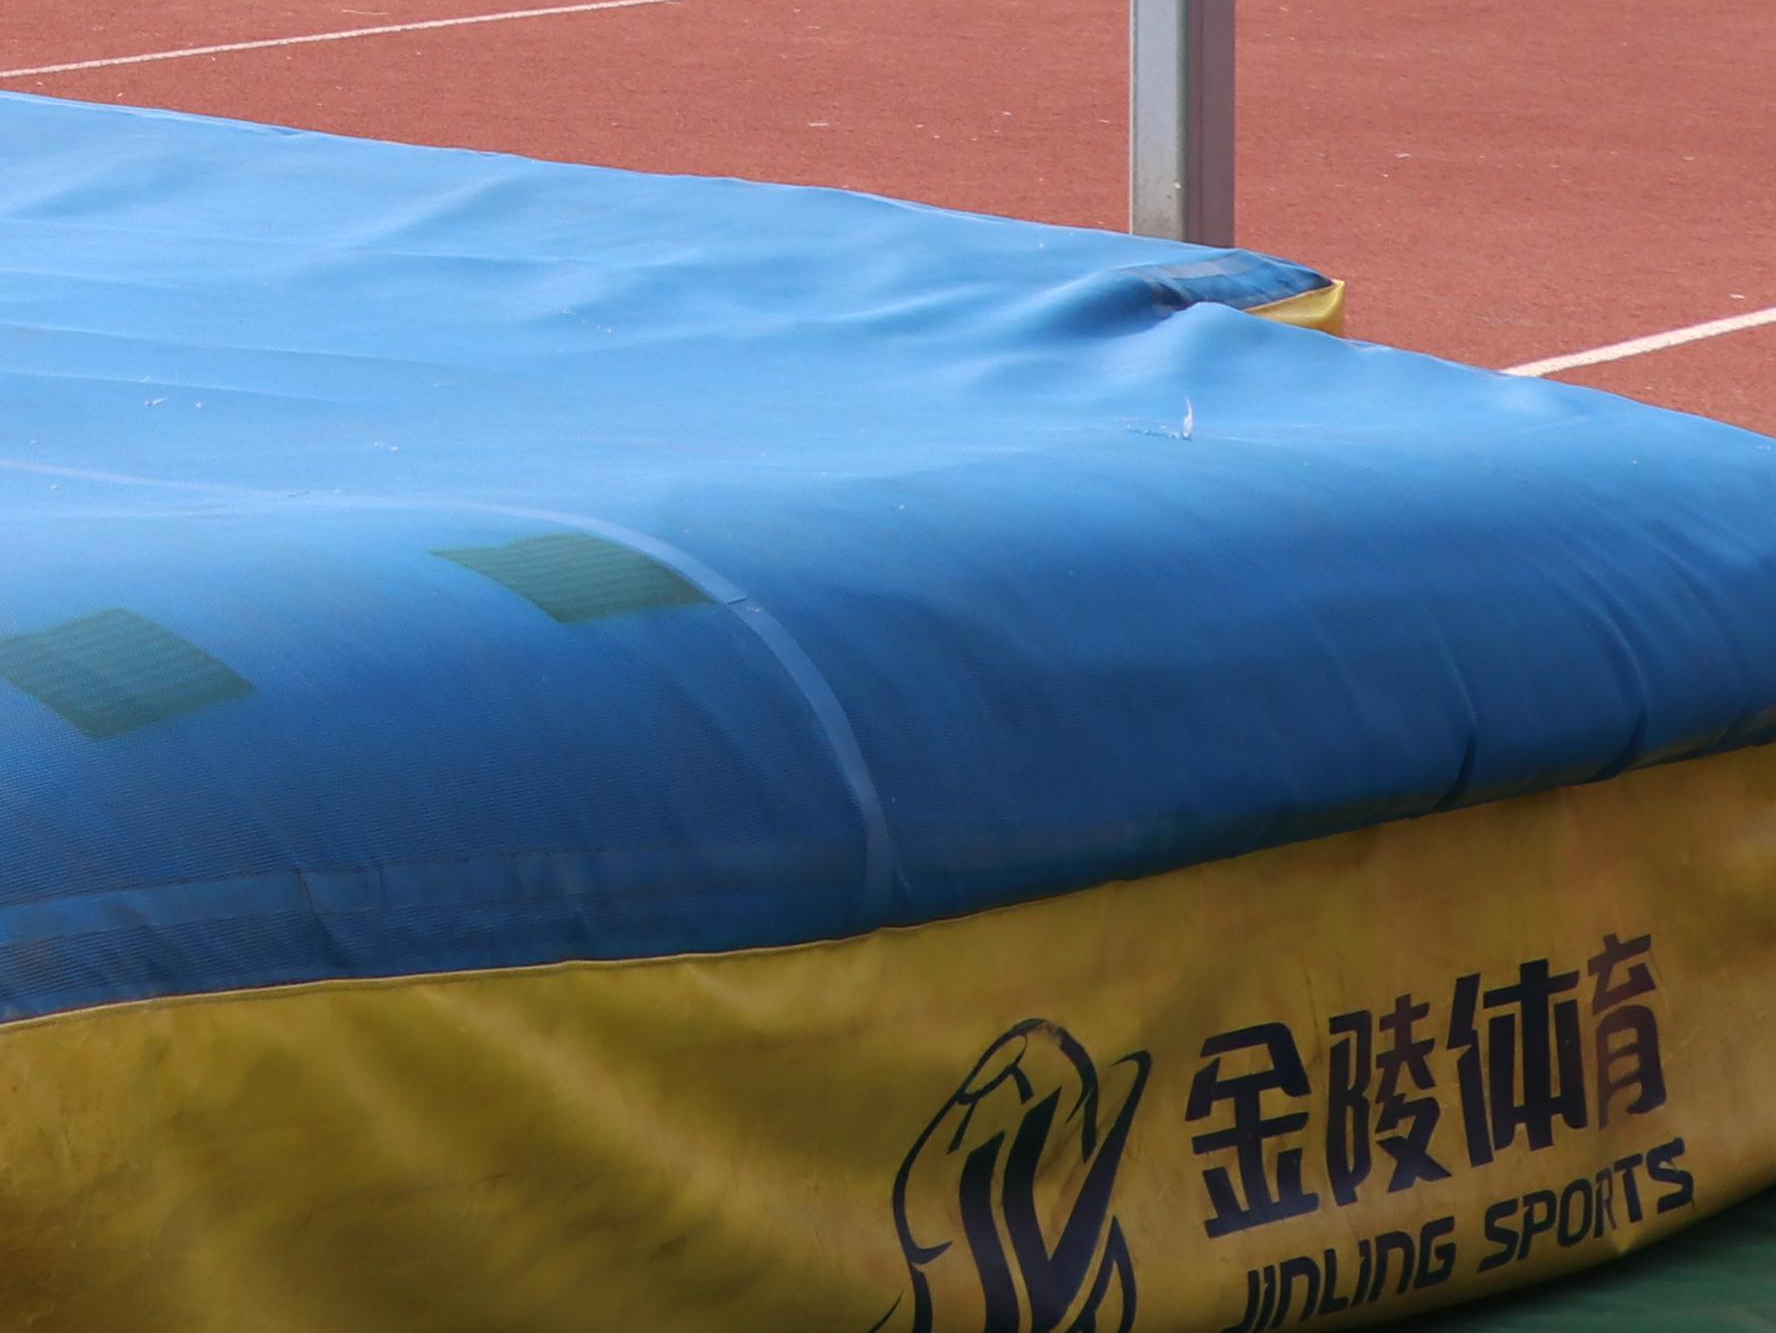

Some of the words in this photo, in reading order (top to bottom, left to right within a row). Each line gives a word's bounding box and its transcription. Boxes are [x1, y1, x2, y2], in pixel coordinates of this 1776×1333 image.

[1185, 933, 1668, 1239] 金陵体育
[1477, 1136, 1696, 1273] SPORTS
